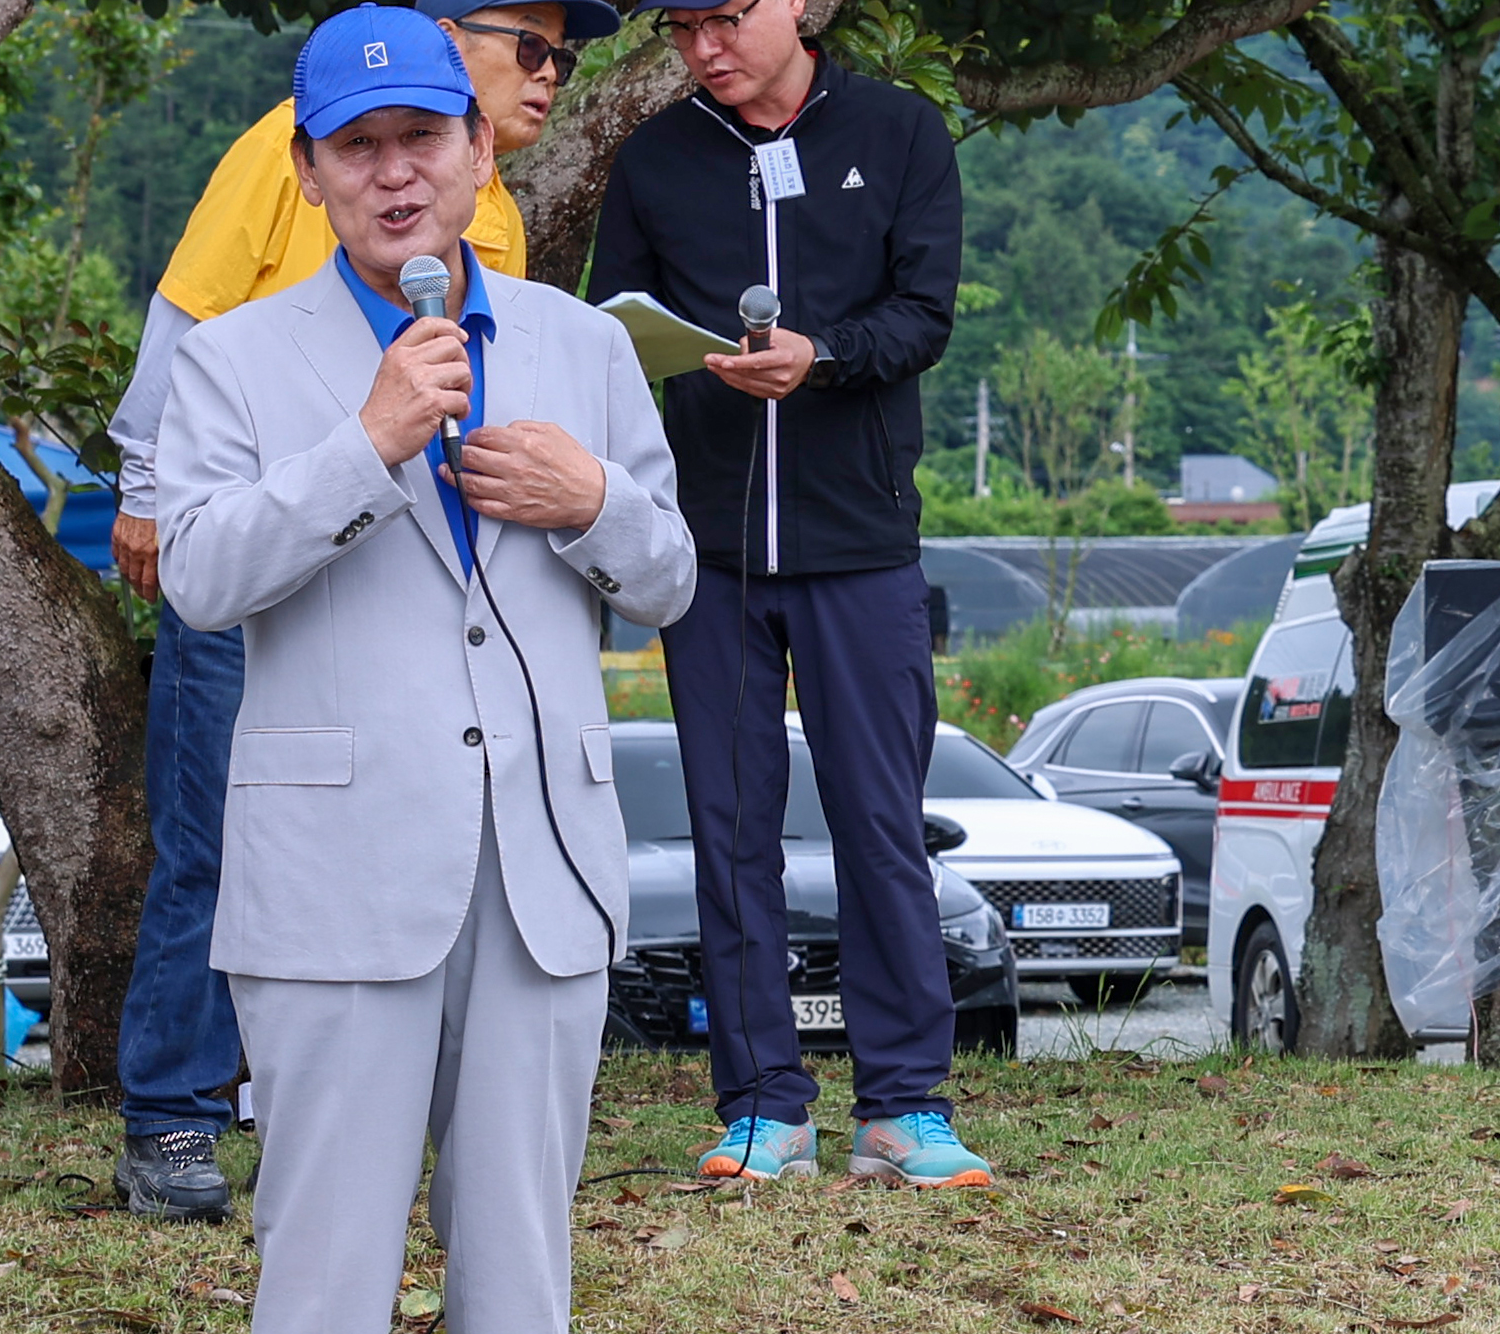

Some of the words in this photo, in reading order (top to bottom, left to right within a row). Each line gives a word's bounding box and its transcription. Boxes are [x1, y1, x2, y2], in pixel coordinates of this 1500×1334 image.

[1253, 781, 1303, 803] AMBULANCE
[1068, 907, 1105, 924] 3352
[793, 1000, 843, 1025] 395
